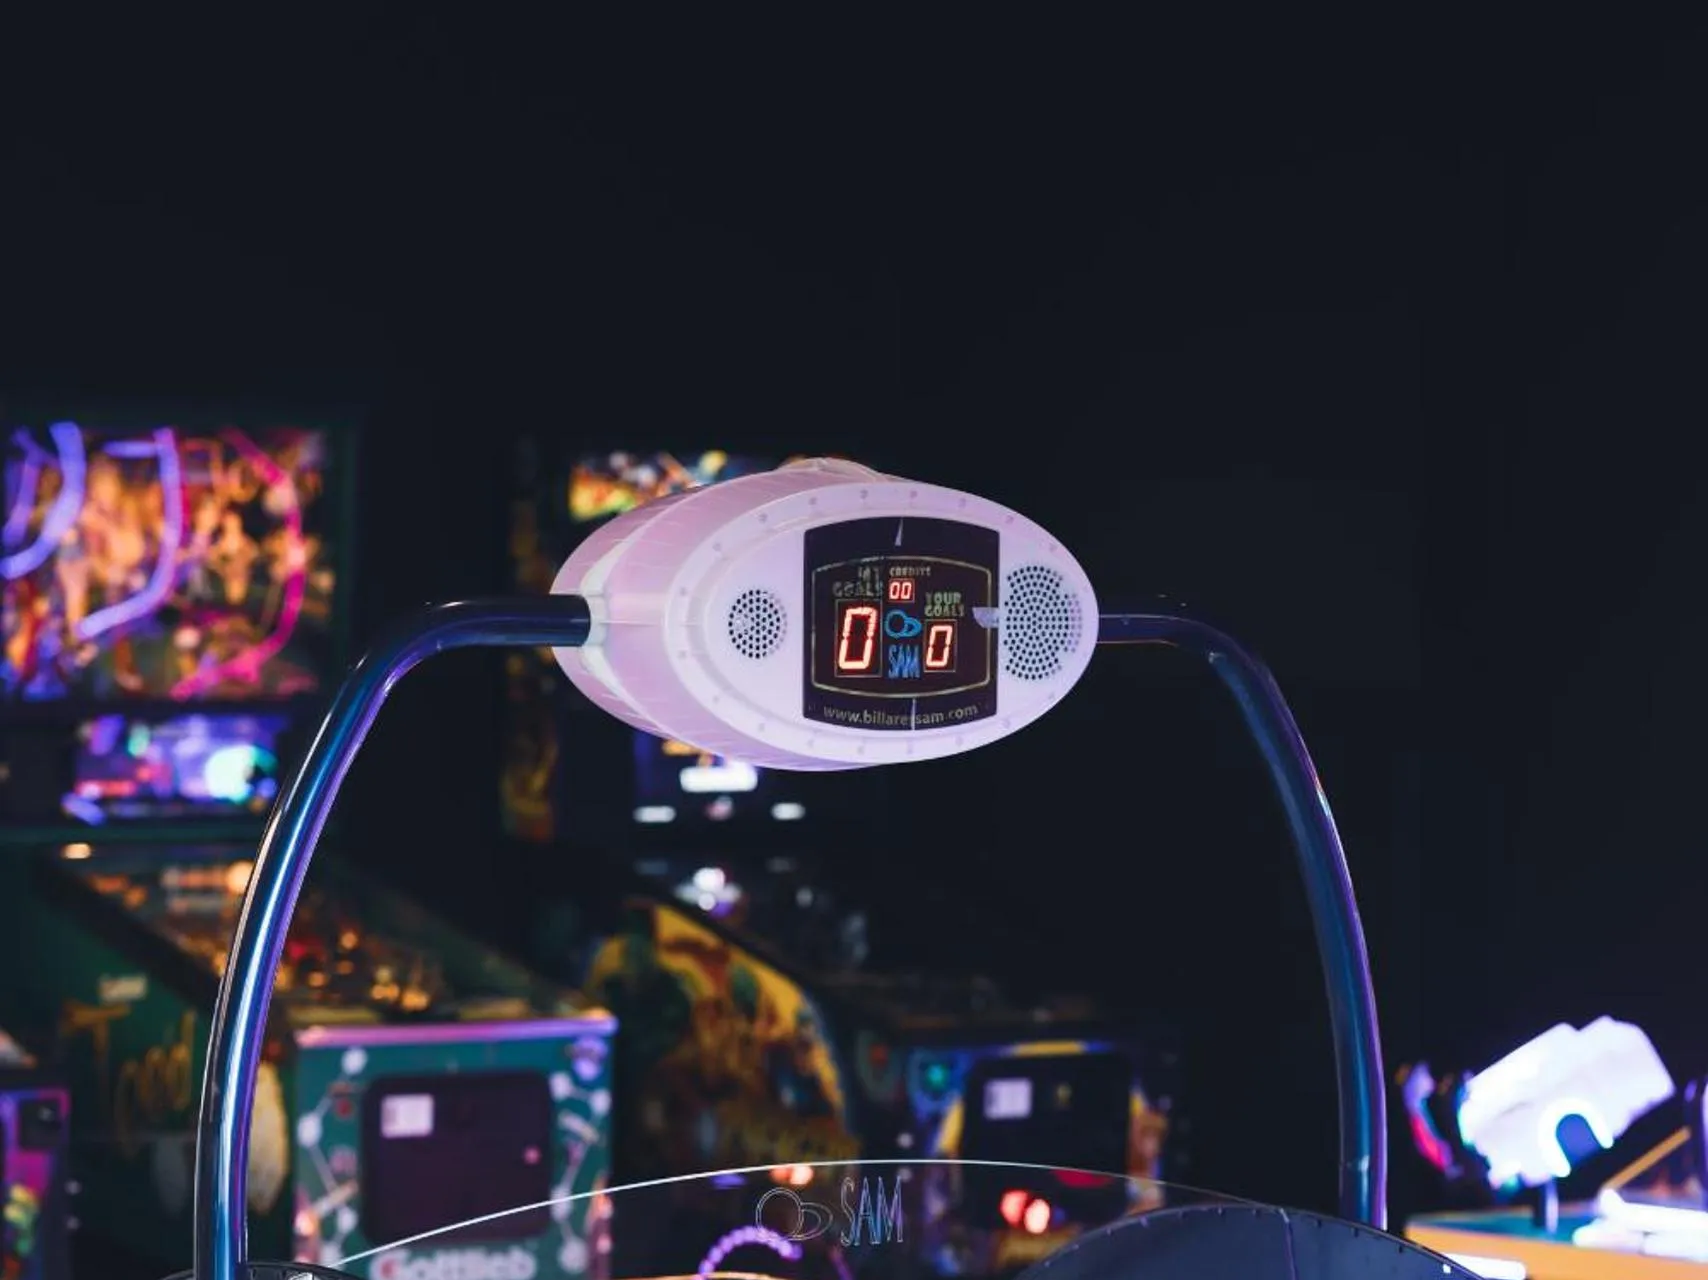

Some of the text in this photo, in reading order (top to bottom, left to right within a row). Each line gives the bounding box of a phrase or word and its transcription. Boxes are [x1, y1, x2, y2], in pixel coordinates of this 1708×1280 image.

[889, 581, 912, 599] 00
[924, 592, 962, 605] YOUR
[838, 606, 877, 669] 0
[925, 624, 953, 667] 0
[888, 645, 921, 679] SAM
[823, 704, 978, 726] www.billaresam.com
[840, 1174, 903, 1246] SAM
